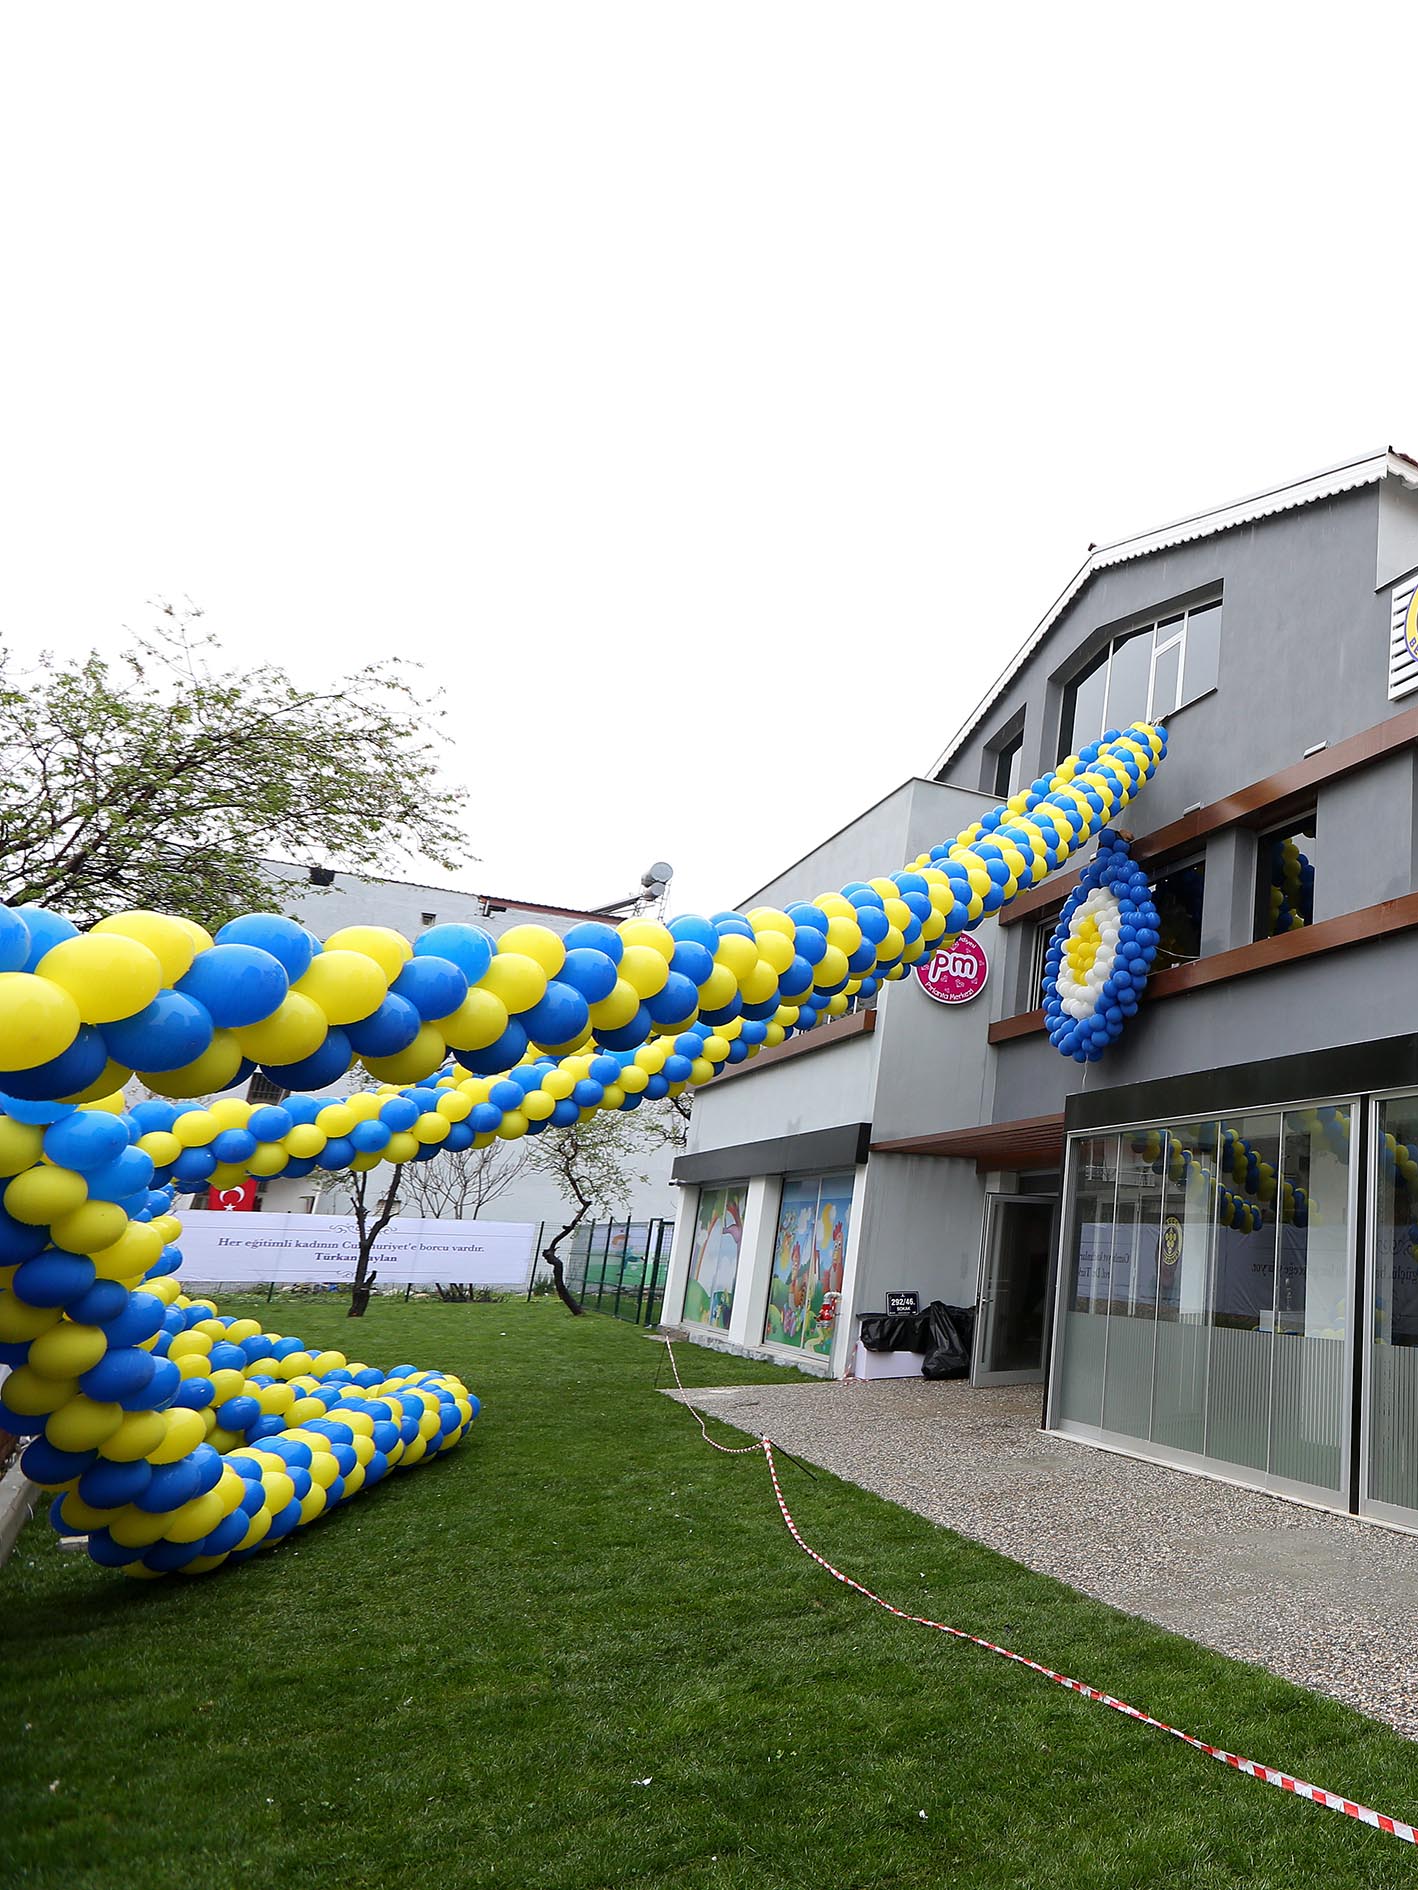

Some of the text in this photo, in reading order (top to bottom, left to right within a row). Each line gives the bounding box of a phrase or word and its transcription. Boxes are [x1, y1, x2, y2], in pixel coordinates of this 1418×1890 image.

[949, 988, 974, 1001] Merkezi
[218, 1238, 242, 1247] Her
[245, 1239, 292, 1249] eğitimli
[295, 1239, 339, 1249] kadının
[420, 1243, 449, 1252] borcu
[452, 1244, 485, 1253] vardır.
[315, 1252, 397, 1263] Türkan aylan
